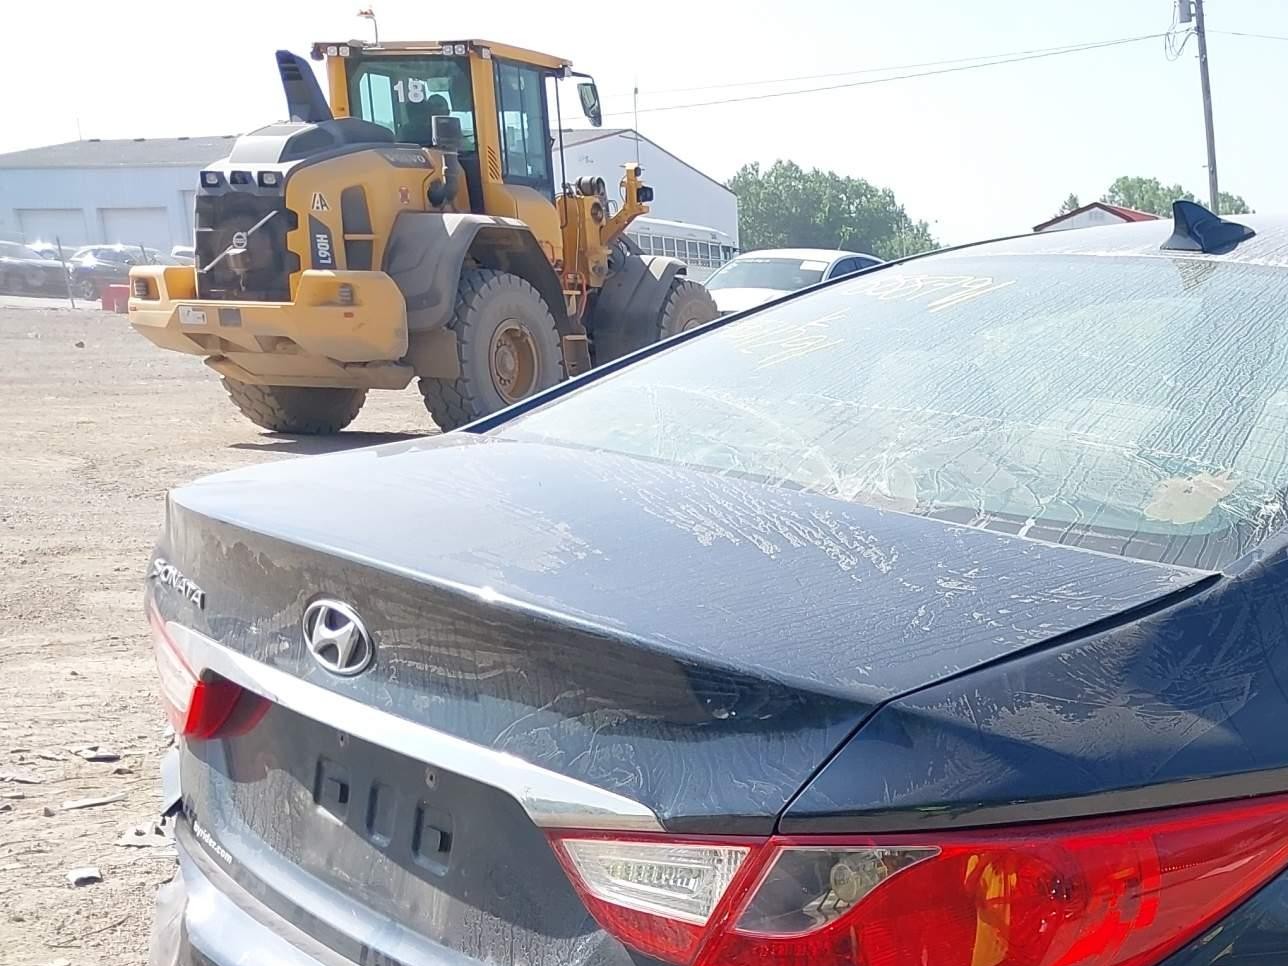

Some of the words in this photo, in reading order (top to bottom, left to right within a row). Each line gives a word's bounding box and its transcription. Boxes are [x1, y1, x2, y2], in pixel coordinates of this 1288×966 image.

[393, 79, 425, 103] 18
[315, 234, 332, 264] L90H
[150, 558, 206, 609] SONATA
